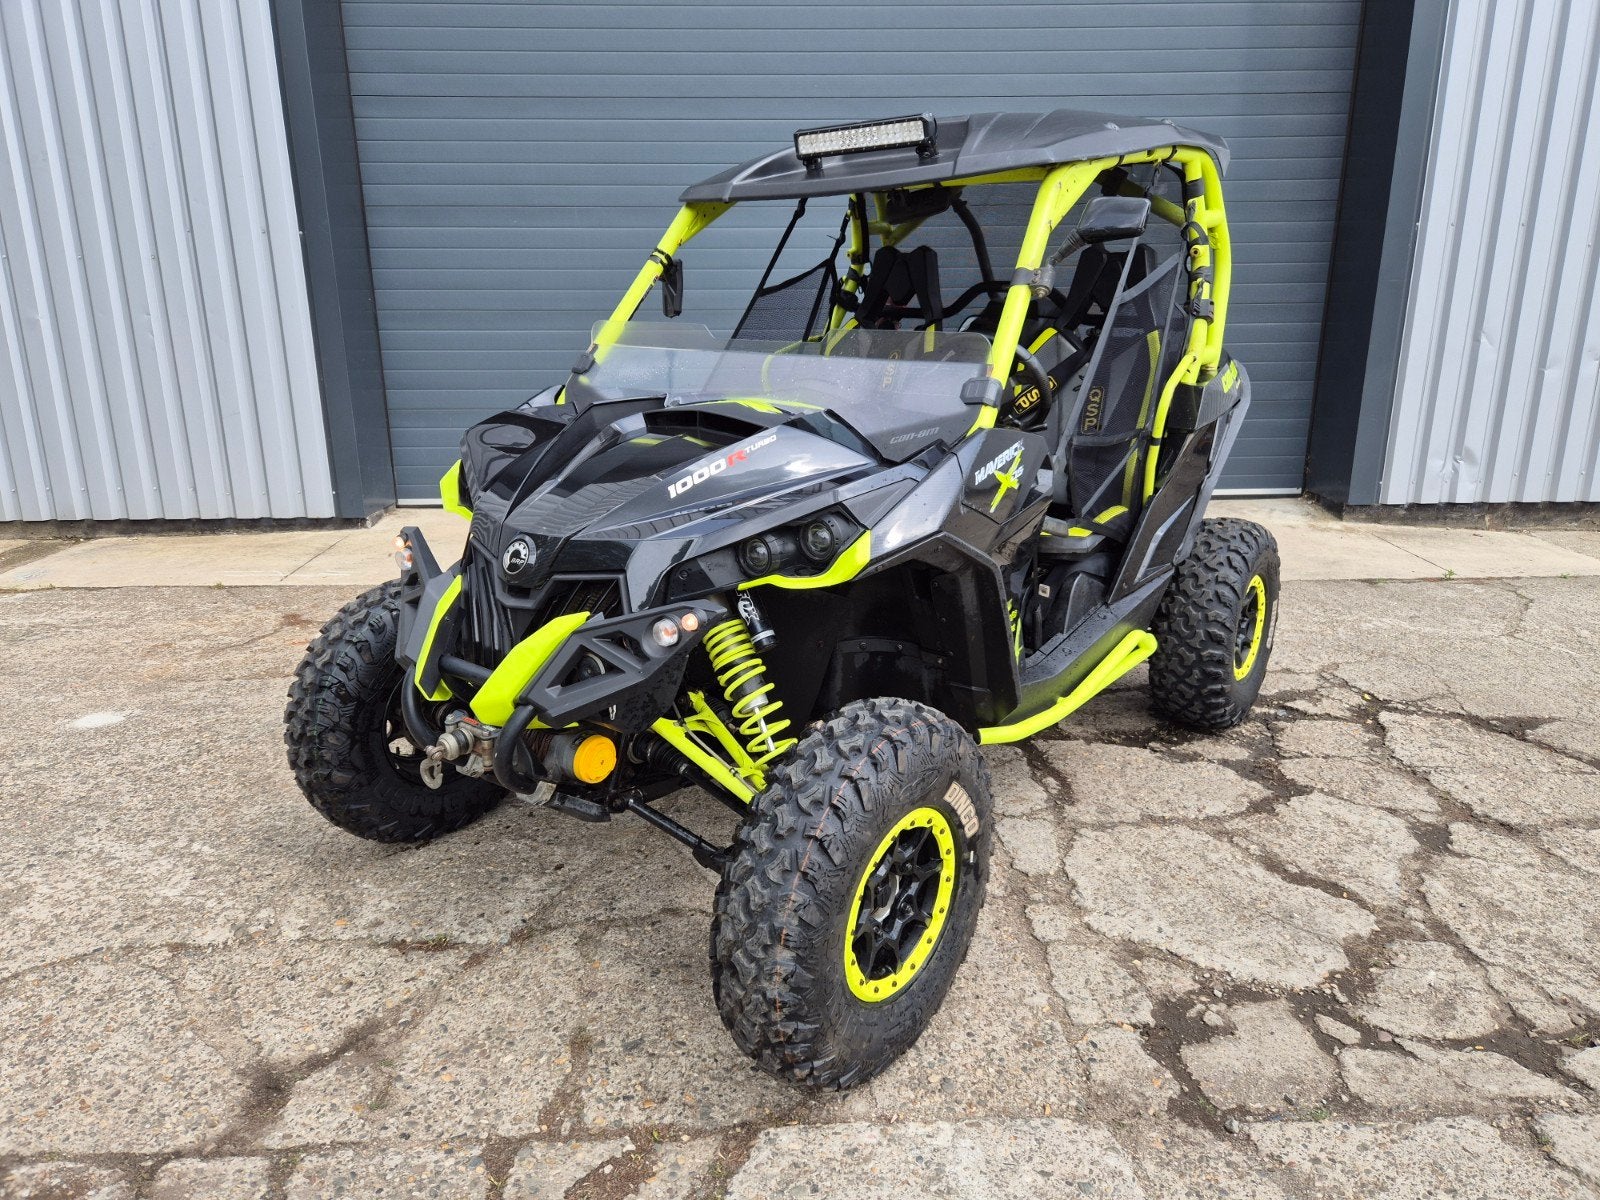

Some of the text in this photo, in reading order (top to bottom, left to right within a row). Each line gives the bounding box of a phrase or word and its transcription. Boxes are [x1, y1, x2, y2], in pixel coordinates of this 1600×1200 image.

[1084, 388, 1101, 431] QSP
[744, 434, 777, 453] TURBO
[890, 426, 940, 445] can-am
[974, 438, 1025, 486] MAVERICK
[511, 557, 525, 565] BRP
[942, 780, 980, 839] DINGO
